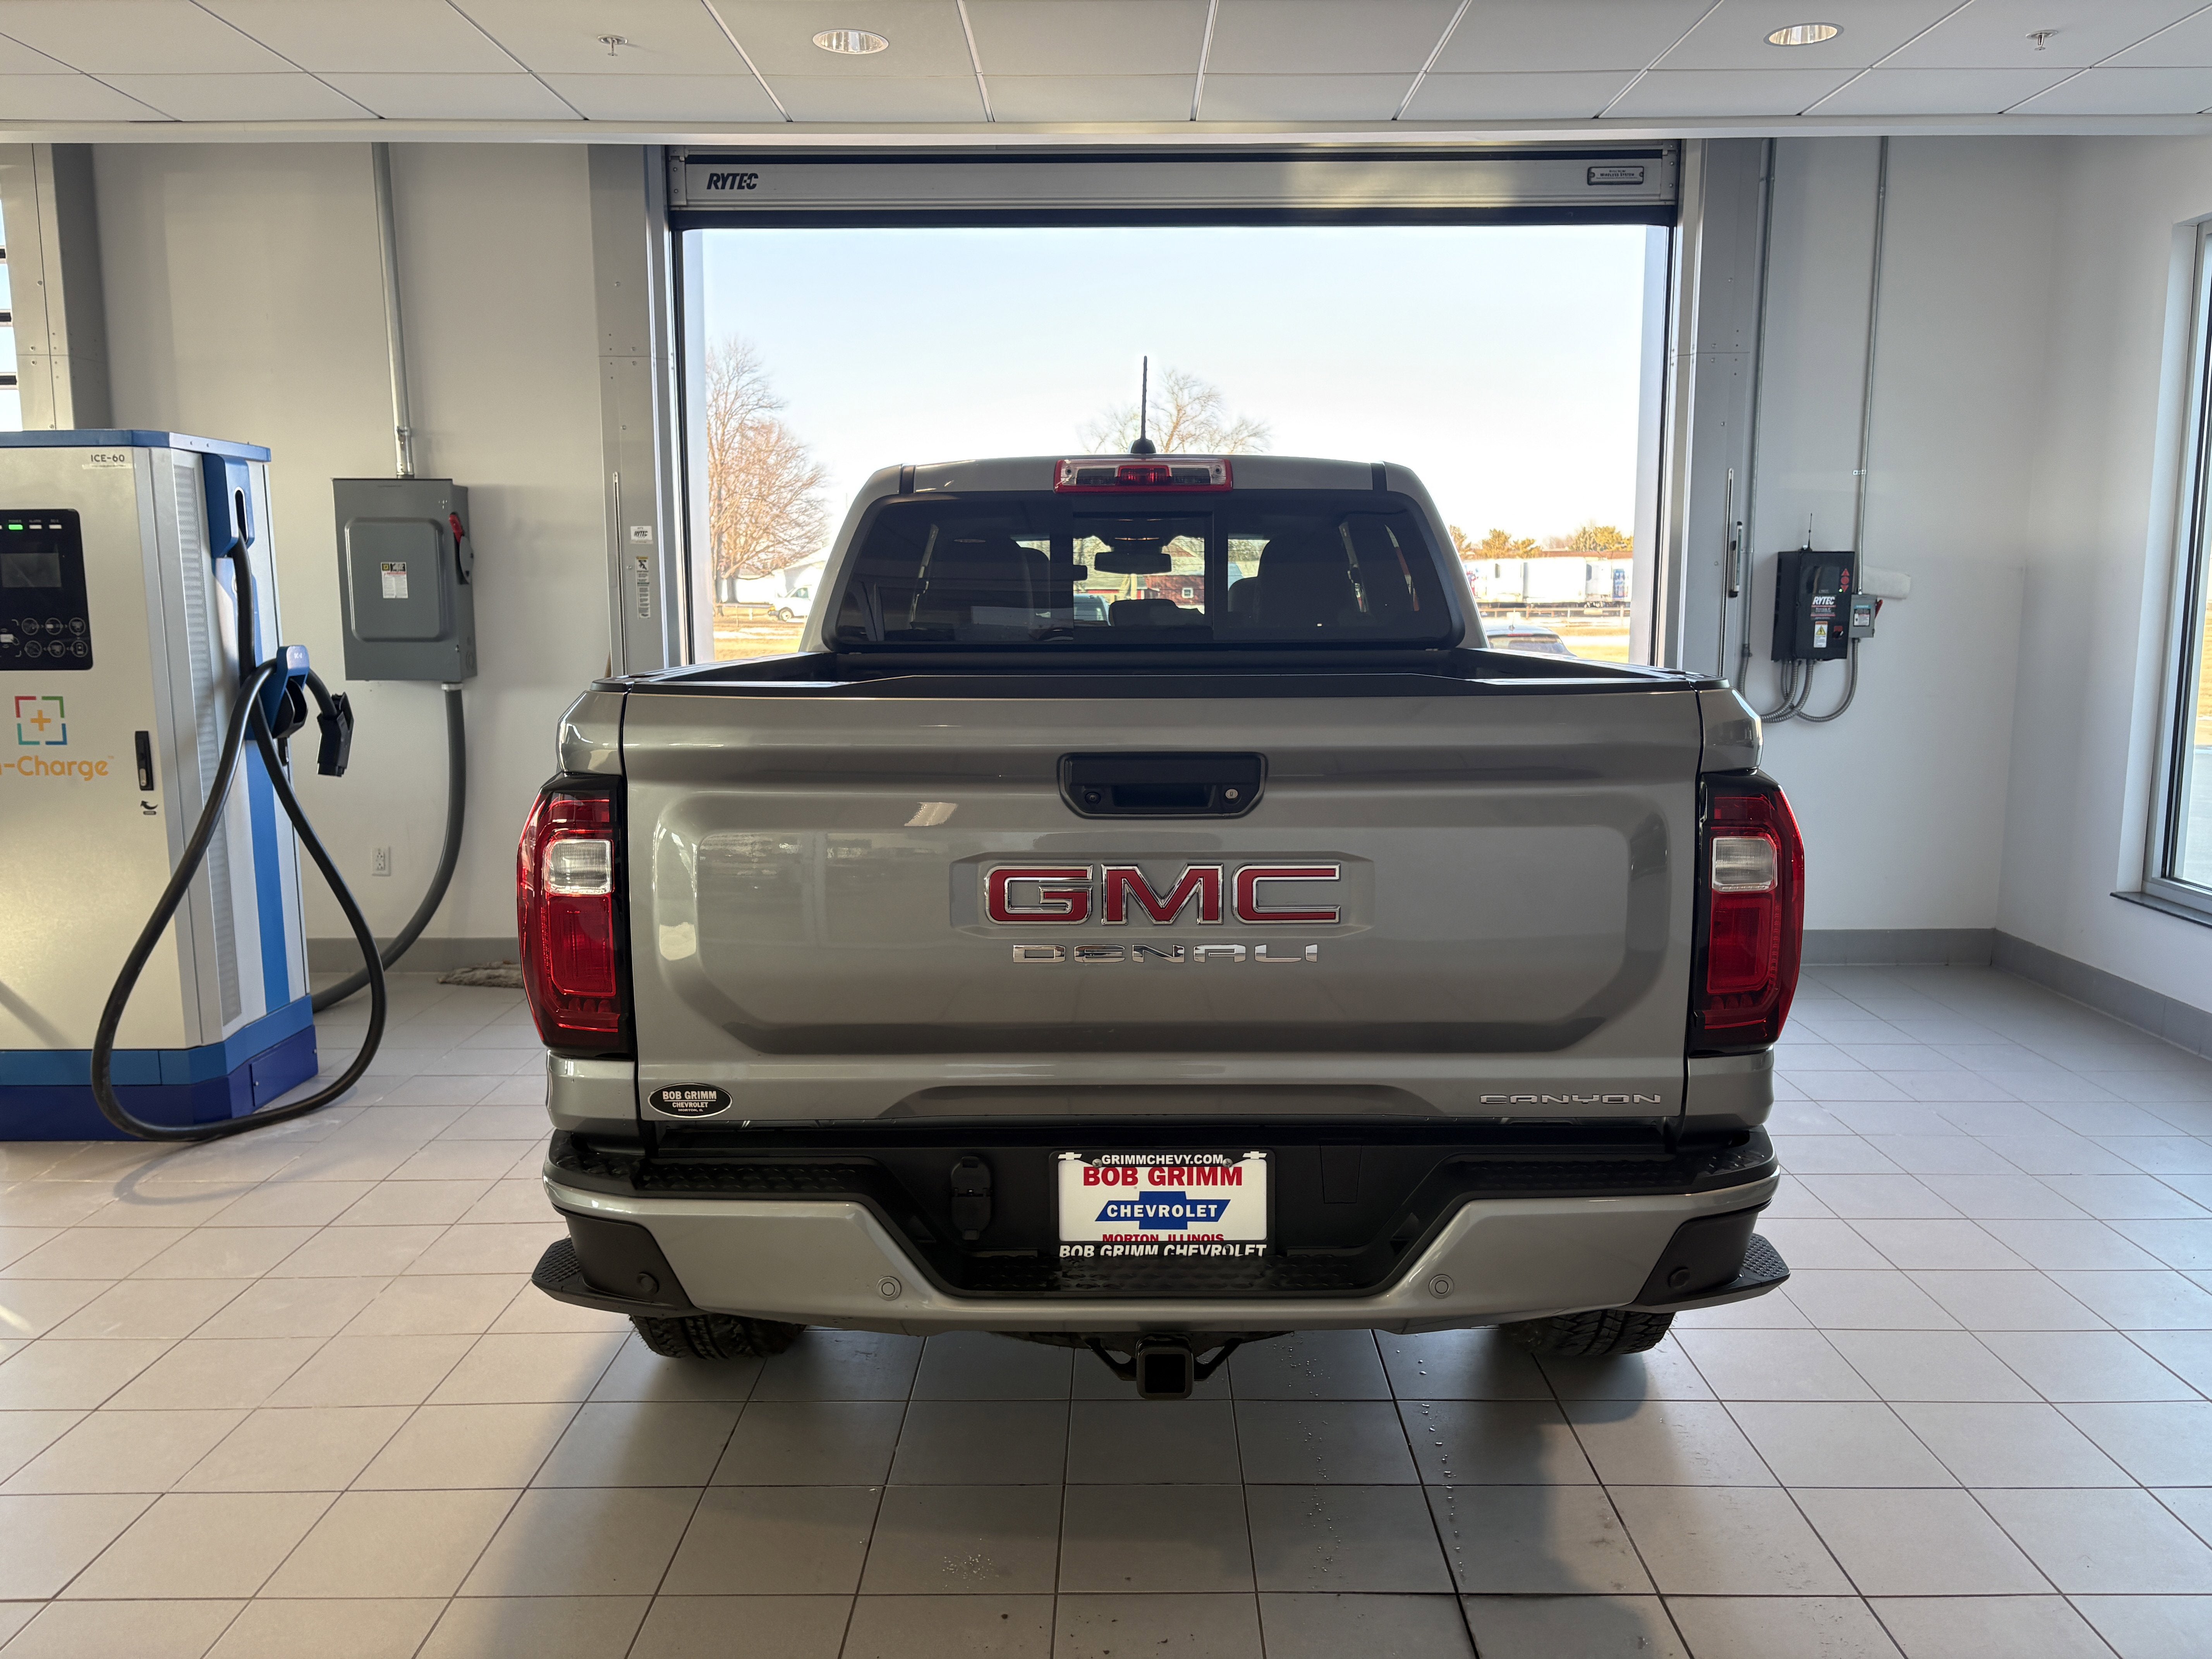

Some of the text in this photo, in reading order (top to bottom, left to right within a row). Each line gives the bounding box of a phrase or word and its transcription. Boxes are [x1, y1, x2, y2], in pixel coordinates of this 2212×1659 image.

[706, 173, 759, 190] RYTEC
[91, 454, 125, 462] ICE-60
[1812, 596, 1836, 605] RYTEC
[0, 755, 109, 781] -Charge
[985, 864, 1341, 926] GMC
[1013, 944, 1317, 963] DENALI
[662, 1091, 717, 1100] BOB GRIMM
[1480, 1094, 1661, 1104] CANYON
[1101, 1154, 1223, 1165] GRIMMCHEVY.COM
[1083, 1166, 1242, 1186] BOB GRIMM
[1106, 1204, 1218, 1218] CHEVROLET
[1059, 1244, 1267, 1258] BOB GRIMM CHEVROLET
